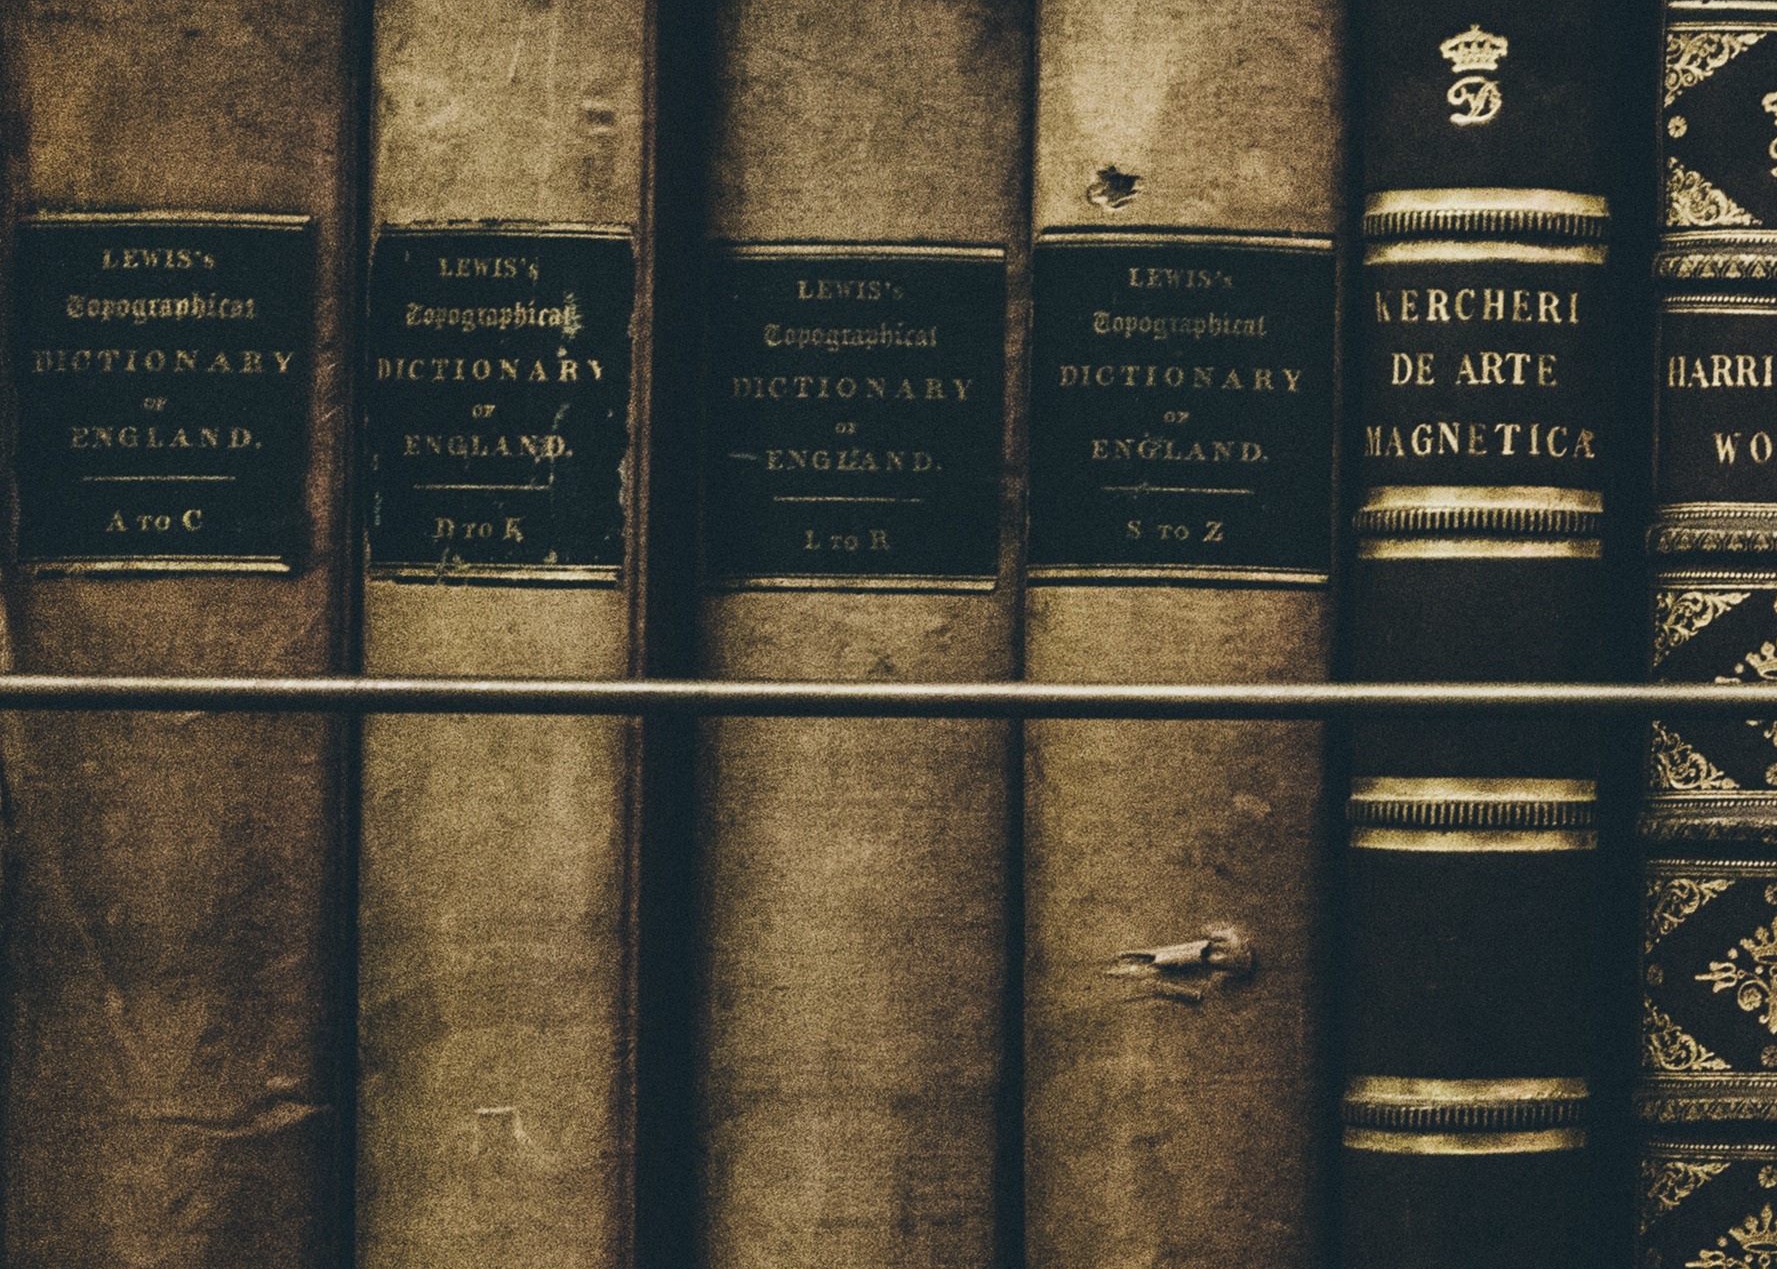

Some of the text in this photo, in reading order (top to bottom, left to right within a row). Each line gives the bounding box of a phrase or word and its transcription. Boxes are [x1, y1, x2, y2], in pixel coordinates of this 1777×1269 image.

[32, 350, 295, 373] DICTIONARY
[378, 358, 603, 381] DICTIONARY
[1391, 351, 1557, 387] DE ARTE
[732, 377, 973, 401] DICTIONARY
[1060, 365, 1301, 392] DICTIONARY
[1364, 422, 1595, 460] MAGNETICA
[106, 509, 127, 531] A
[182, 509, 203, 531] C
[435, 518, 454, 538] D
[1128, 520, 1141, 540] S
[1203, 520, 1223, 542] Z
[805, 530, 820, 550] L
